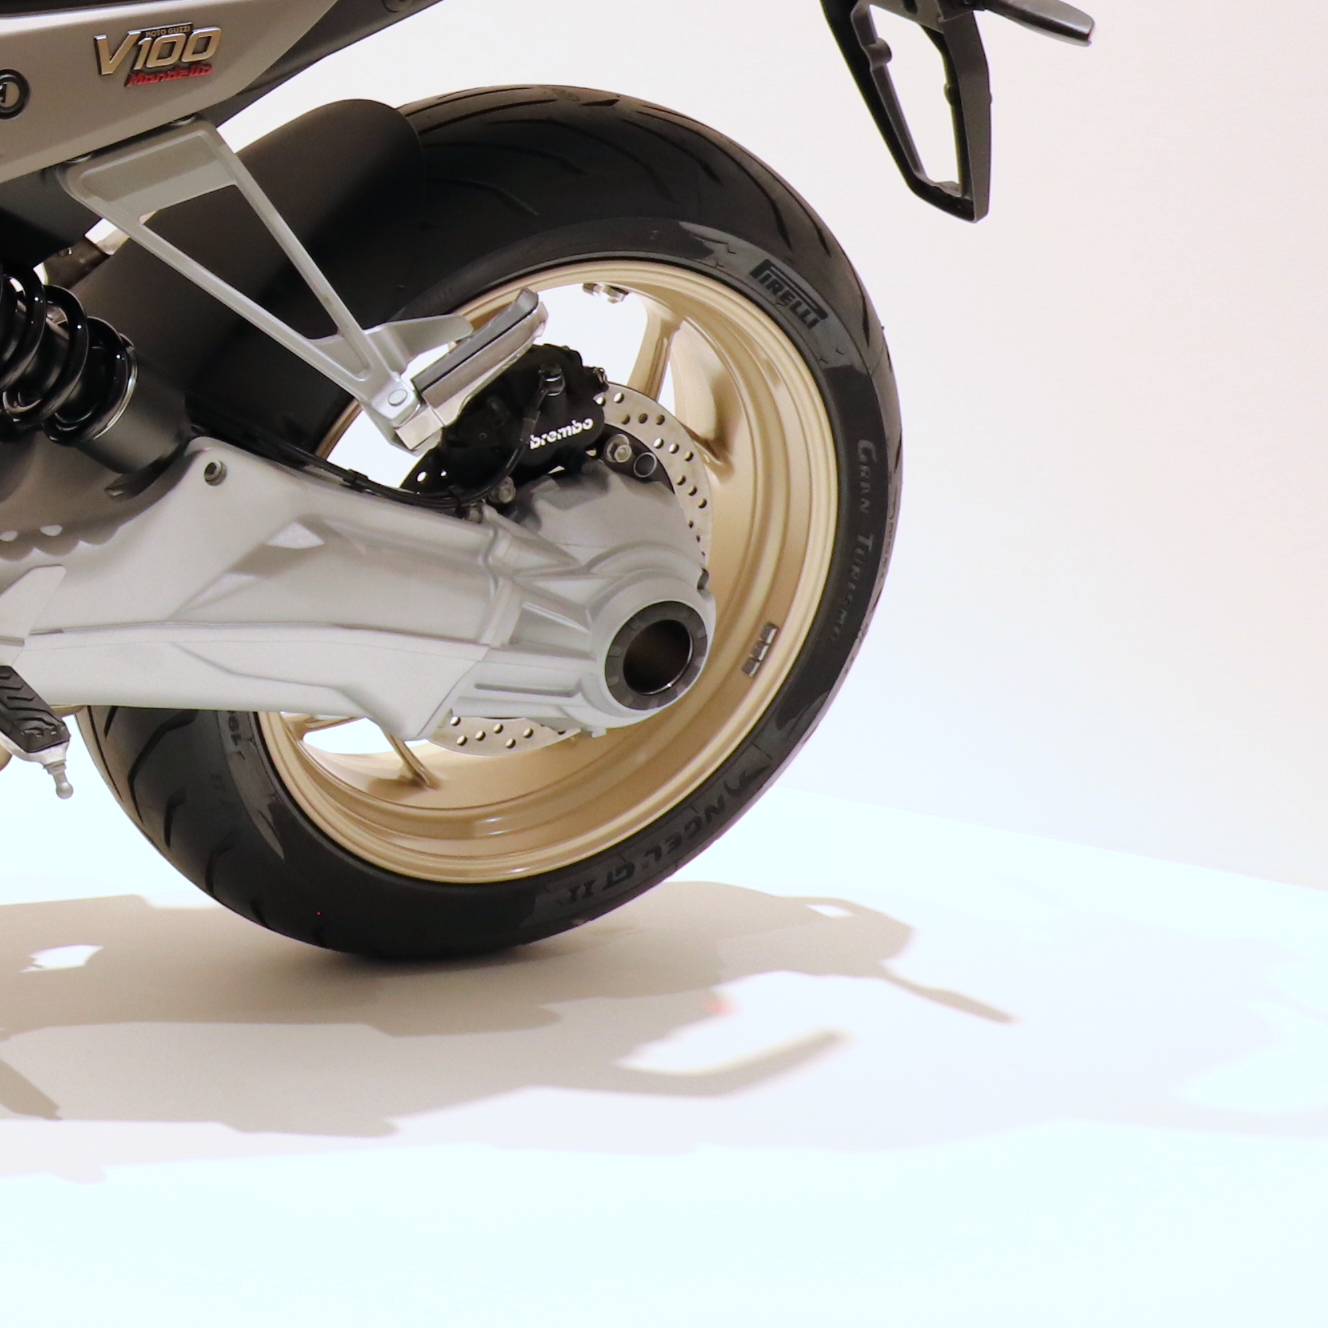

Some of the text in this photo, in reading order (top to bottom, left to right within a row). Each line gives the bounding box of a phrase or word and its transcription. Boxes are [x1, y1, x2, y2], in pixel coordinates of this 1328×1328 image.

[94, 26, 222, 75] V100
[146, 29, 166, 38] MOTO
[749, 259, 828, 329] PIRELLI
[529, 417, 594, 450] brembo
